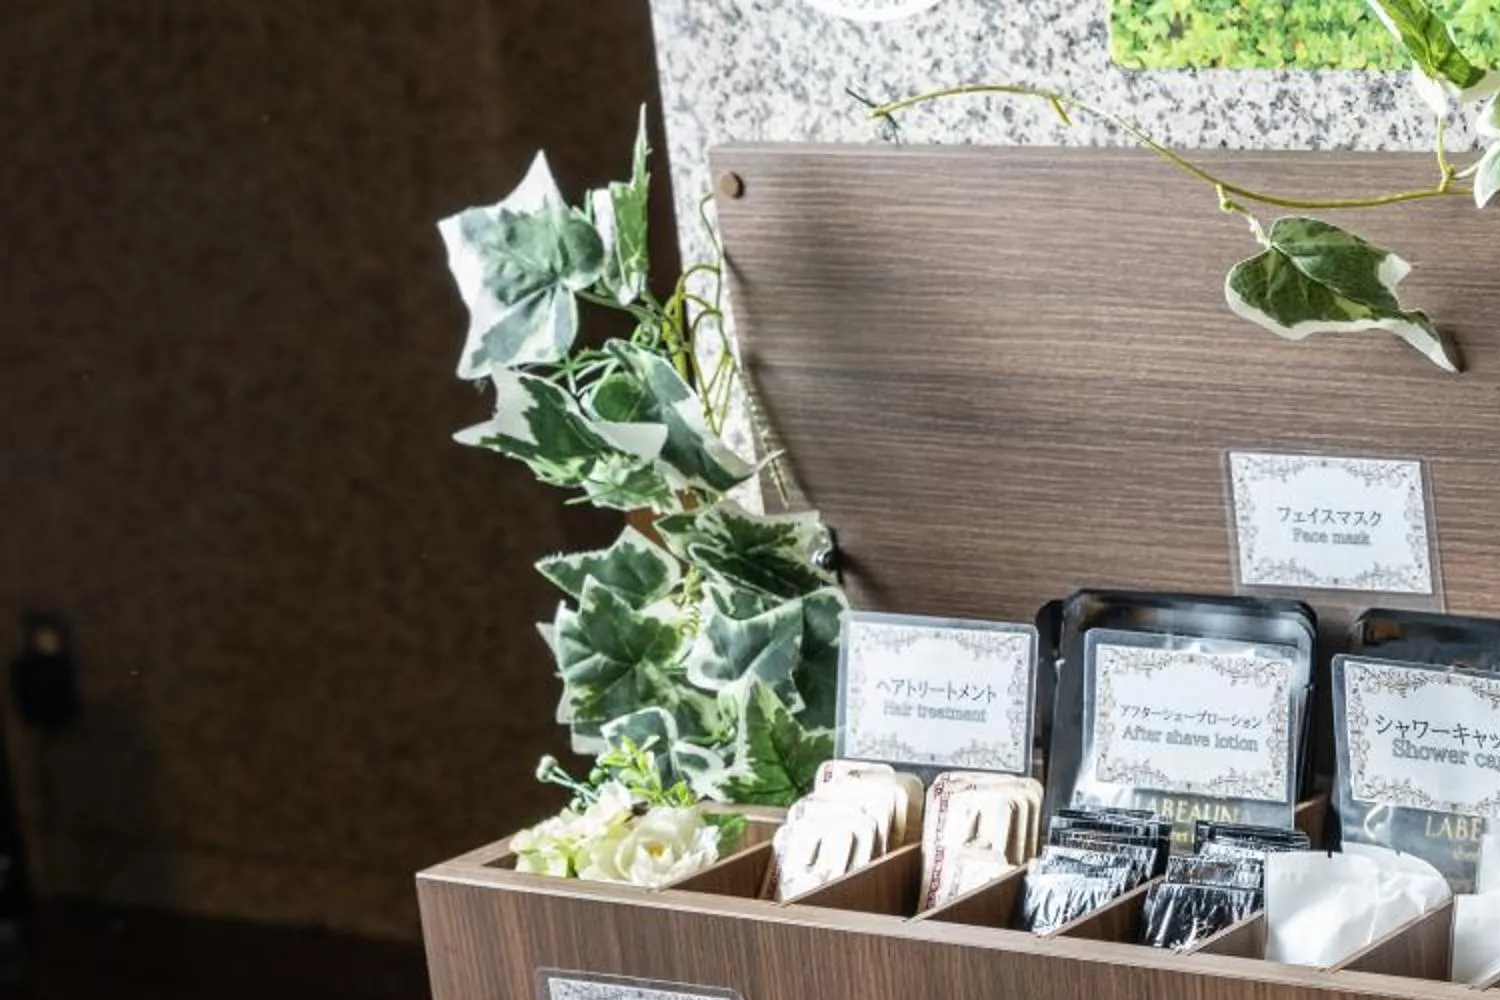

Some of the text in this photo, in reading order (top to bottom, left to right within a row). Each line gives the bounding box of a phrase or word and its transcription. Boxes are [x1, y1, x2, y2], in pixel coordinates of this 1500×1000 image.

[1278, 507, 1382, 527] フェイスマスク
[1293, 528, 1372, 545] Face mask
[877, 679, 998, 704] ヘアトリートメント
[883, 701, 987, 723] Hair treatment
[1122, 726, 1259, 752] After shave lotion
[1392, 737, 1469, 765] Shower
